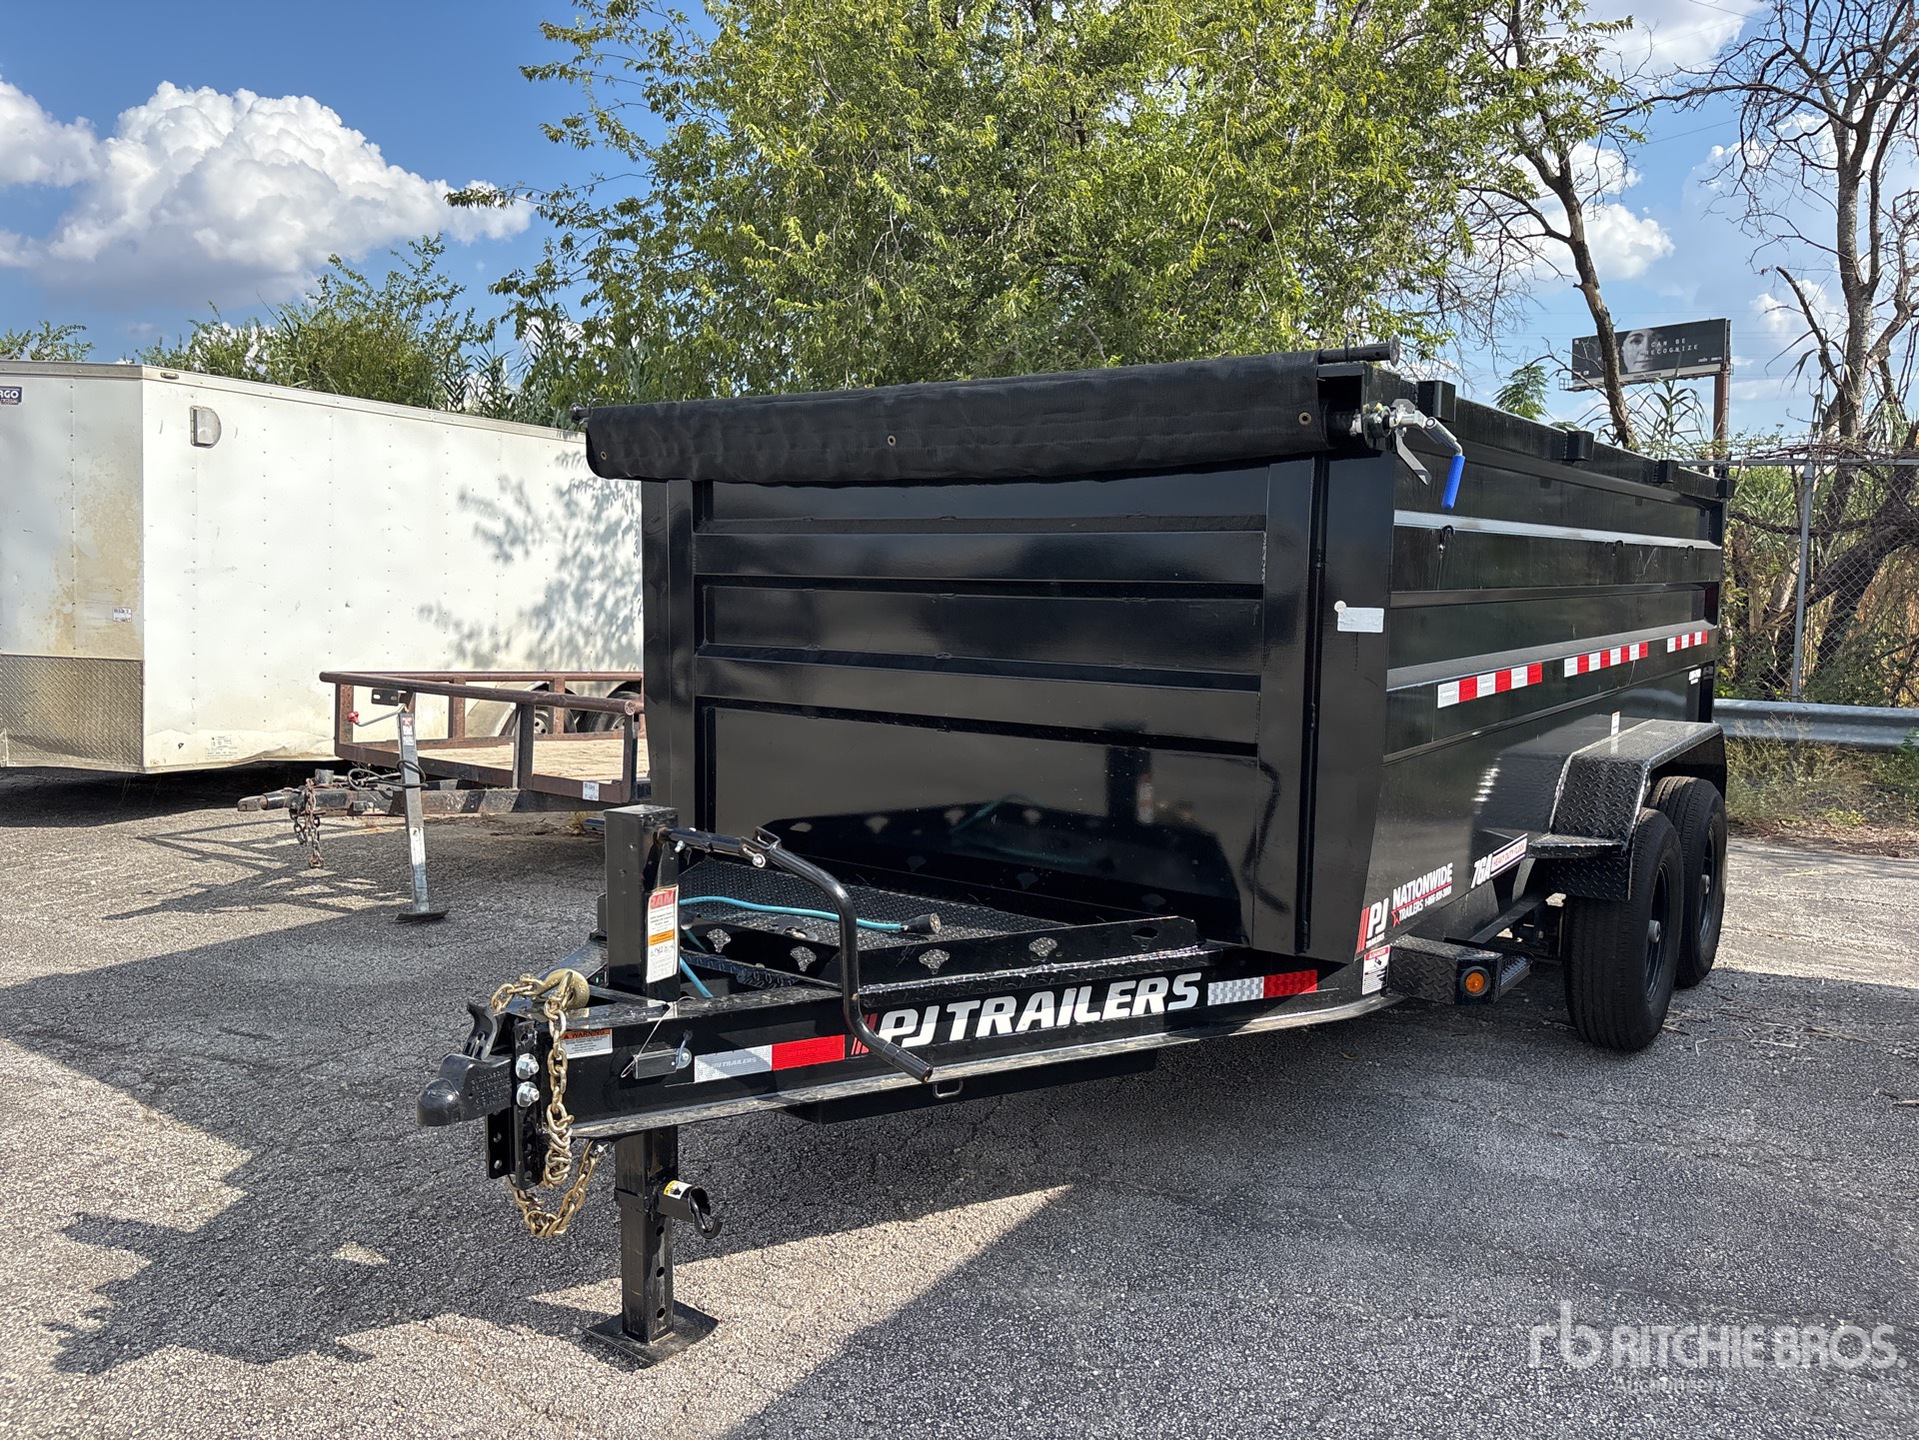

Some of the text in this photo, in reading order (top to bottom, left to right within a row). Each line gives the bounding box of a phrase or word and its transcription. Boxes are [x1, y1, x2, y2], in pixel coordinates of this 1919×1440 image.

[1650, 340, 1667, 348] CAN
[1392, 862, 1453, 910] NATIONWIDE
[1366, 897, 1389, 940] PJ
[1398, 899, 1424, 922] TRAILERS
[878, 972, 1202, 1049] PJ TRAILERS
[572, 1029, 608, 1039] WARNING
